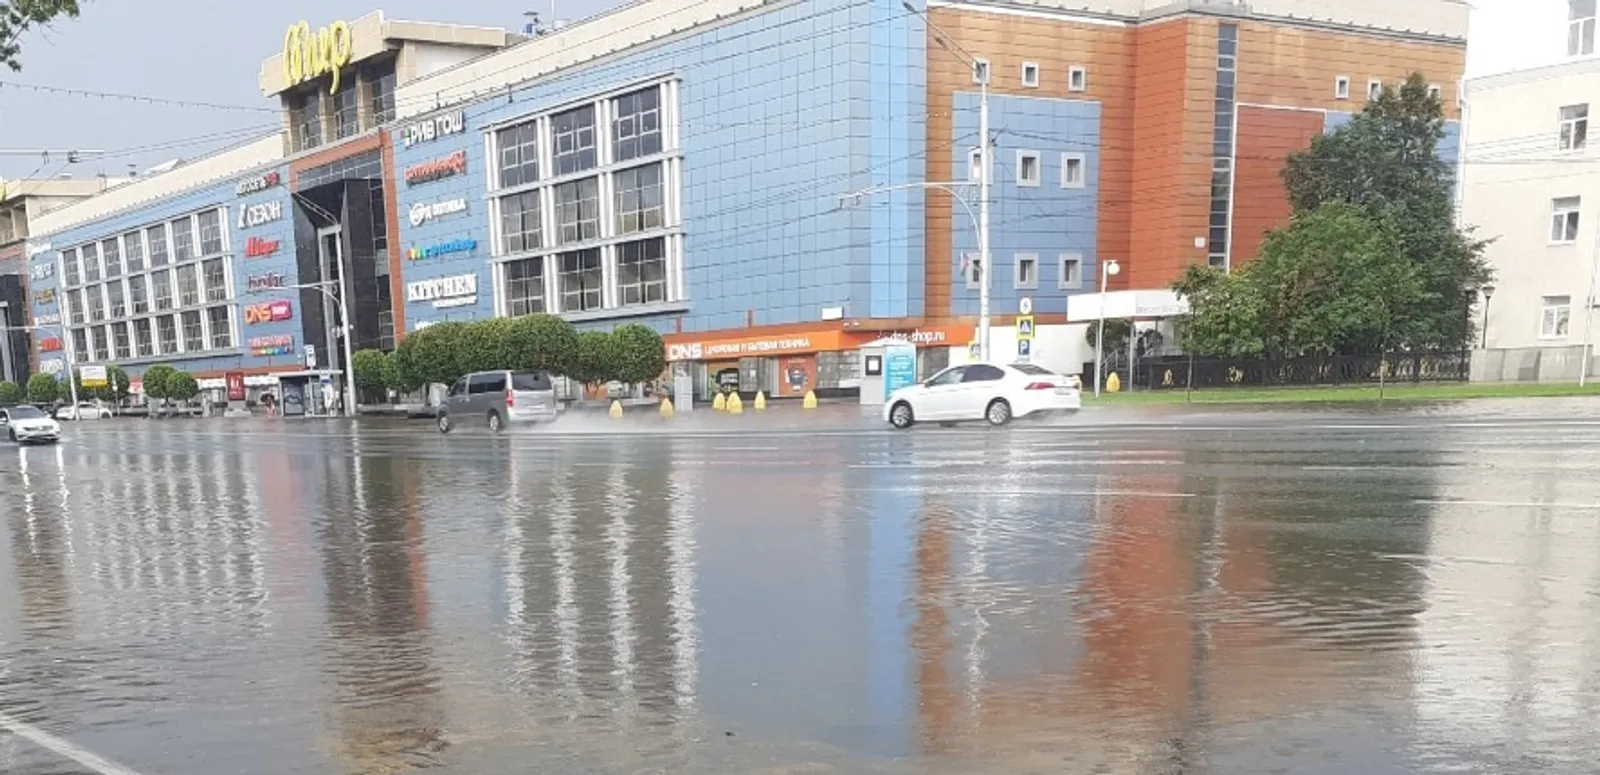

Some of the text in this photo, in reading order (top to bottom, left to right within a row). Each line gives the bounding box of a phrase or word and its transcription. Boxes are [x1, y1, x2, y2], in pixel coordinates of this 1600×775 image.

[408, 274, 477, 301] KITCHEN
[244, 303, 272, 323] DNS
[670, 343, 702, 359] DNS
